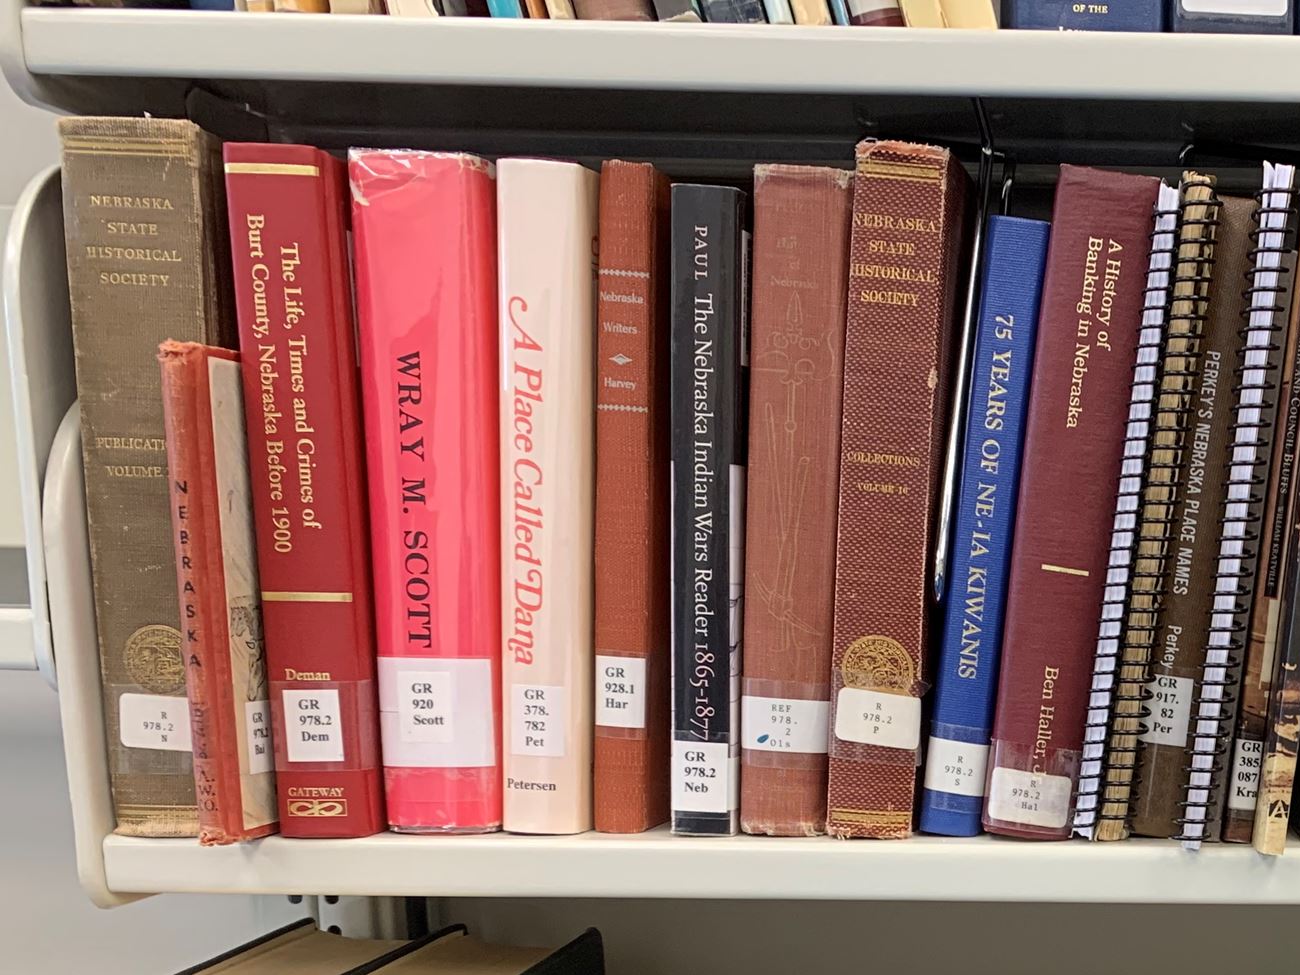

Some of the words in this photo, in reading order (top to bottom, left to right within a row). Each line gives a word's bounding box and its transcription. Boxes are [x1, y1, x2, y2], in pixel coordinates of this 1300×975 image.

[1073, 3, 1086, 13] OF
[1088, 4, 1108, 14] THE
[246, 213, 266, 258] Burt
[853, 214, 938, 233] NEBRASKA
[868, 240, 916, 256] STATE
[280, 242, 300, 282] The
[851, 266, 937, 283] HISTORICAL
[250, 260, 271, 339] County,
[284, 286, 306, 331] Life,
[599, 290, 644, 304] Nebraska
[508, 295, 543, 352] A
[603, 322, 638, 335] Writers
[994, 314, 1014, 340] 75
[288, 333, 308, 393] Times
[258, 344, 278, 435] Nebraska
[604, 376, 637, 391] Harvey
[984, 350, 1014, 433] YEARS
[1198, 350, 1222, 420] PERKEY'S
[293, 397, 314, 433] and
[396, 351, 425, 462] WRAY
[512, 362, 544, 452] Place
[981, 438, 1002, 476] OF
[1187, 424, 1211, 494] NEBRASKA
[266, 439, 284, 502] Before
[296, 437, 319, 503] Crimes
[400, 476, 427, 514] M.
[301, 507, 322, 529] of
[513, 457, 545, 567] Called
[1179, 499, 1200, 544] PLACE
[271, 506, 292, 553] 1900
[1172, 546, 1195, 596] NAMES
[403, 530, 433, 649] SCOTT
[508, 568, 545, 666] Dana
[957, 565, 988, 680] KIWANIS
[1161, 624, 1183, 669] Perkey
[284, 668, 331, 681] Deman
[1157, 678, 1178, 690] GR
[523, 689, 545, 701] GR
[604, 682, 636, 694] 928.1
[1155, 692, 1180, 705] 917.
[298, 699, 320, 711] GR
[523, 704, 550, 717] 378.
[604, 698, 629, 710] Har
[1160, 708, 1175, 719] 82
[299, 714, 333, 727] 978.2
[412, 714, 445, 726] Scott
[862, 713, 893, 725] 978.2
[1152, 723, 1173, 735] Per
[300, 730, 330, 743] Dem
[506, 777, 557, 792] Petersen
[683, 766, 717, 779] 978.2
[287, 786, 344, 798] GATEWAY
[683, 782, 709, 794] Neb
